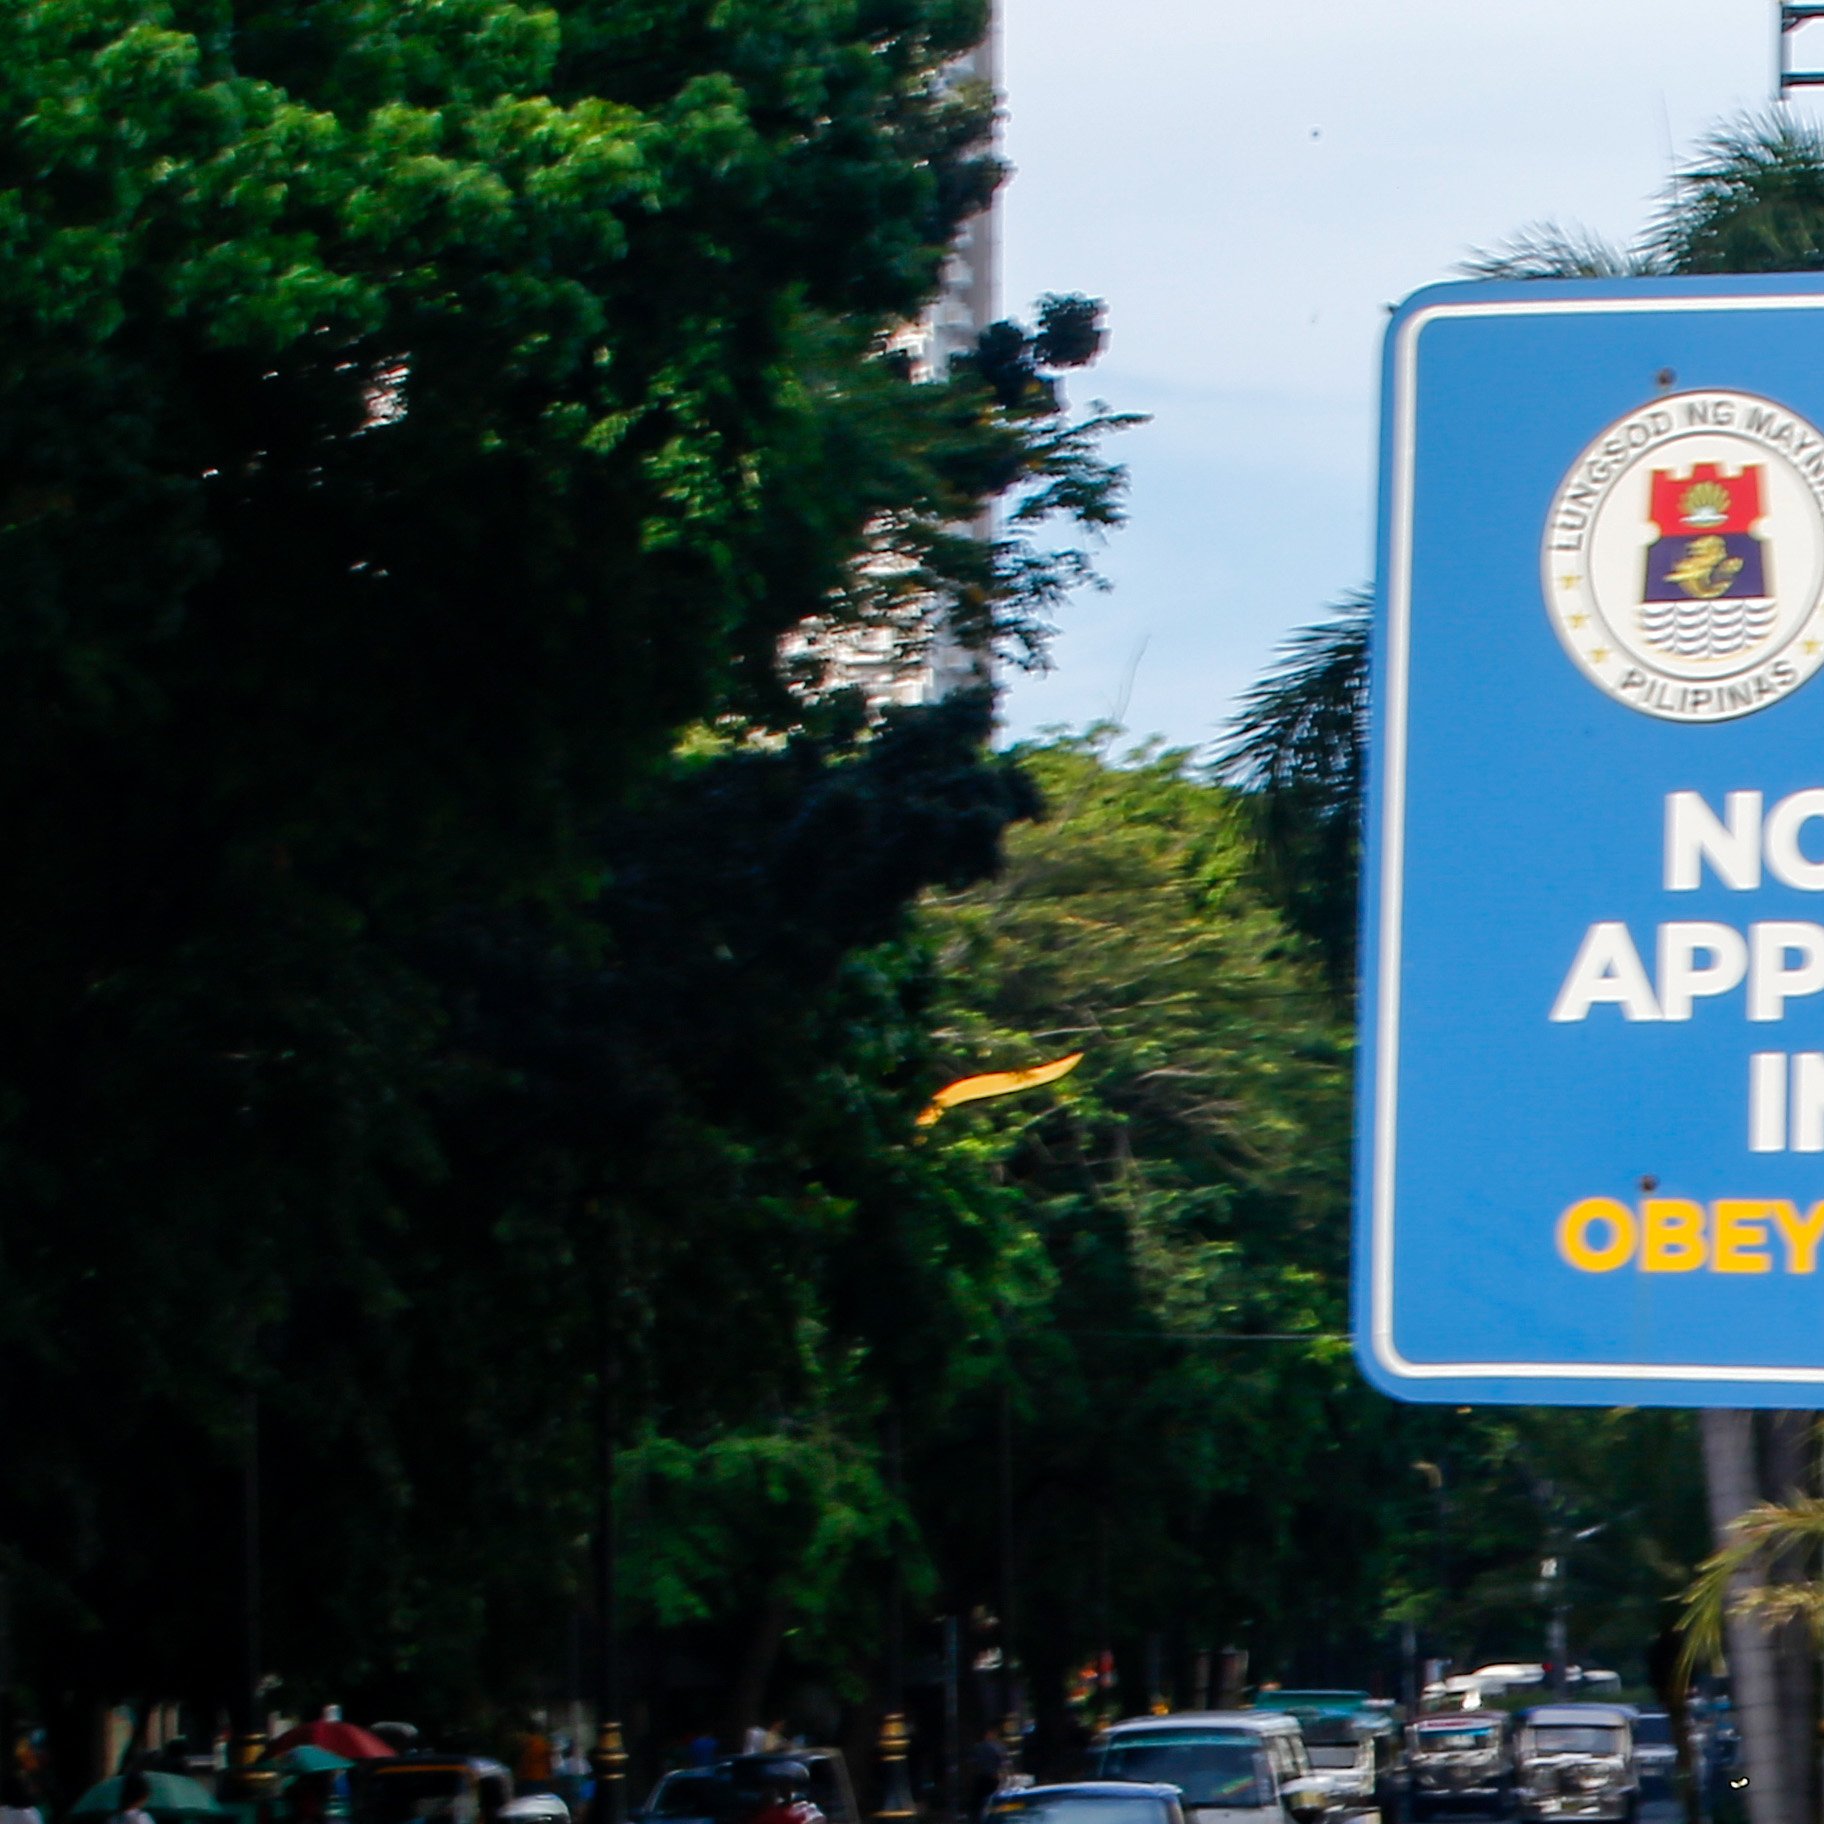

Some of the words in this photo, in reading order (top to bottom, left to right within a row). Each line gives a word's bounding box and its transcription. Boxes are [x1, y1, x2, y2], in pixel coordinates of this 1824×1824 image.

[1549, 409, 1673, 552] LUNGSOD
[1686, 400, 1736, 427] NG
[1618, 659, 1798, 714] PILIPINAS
